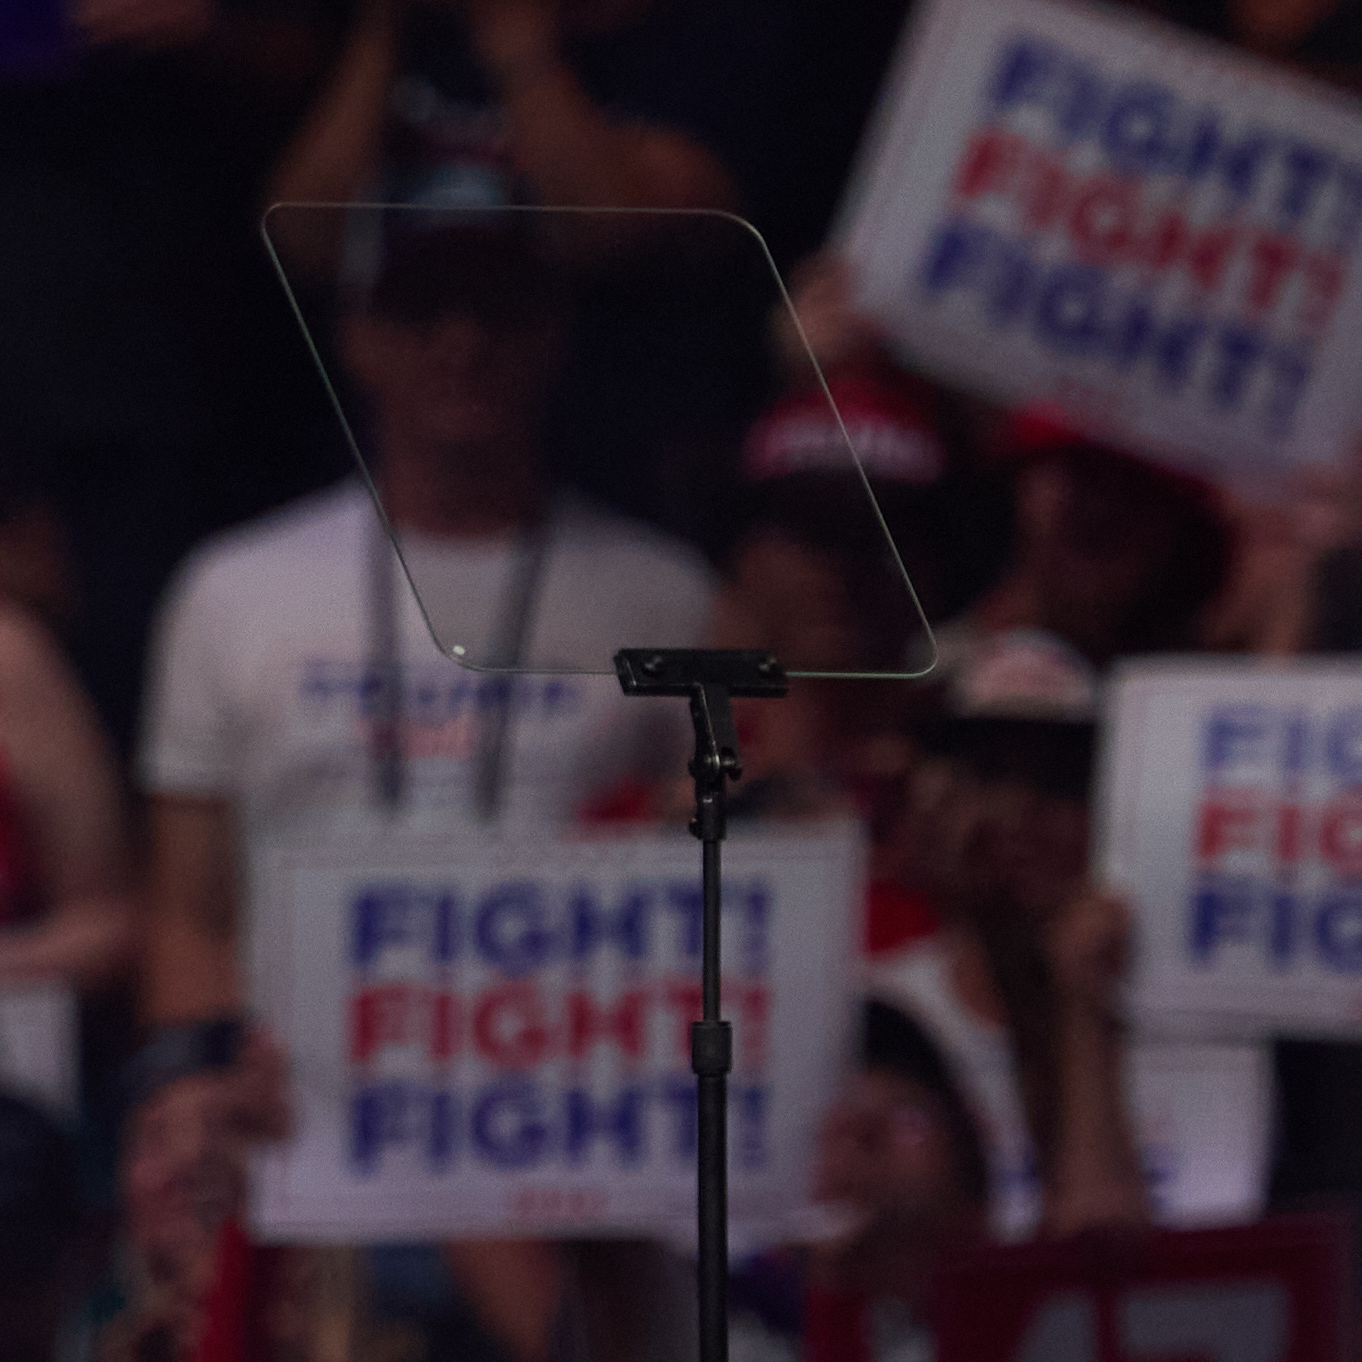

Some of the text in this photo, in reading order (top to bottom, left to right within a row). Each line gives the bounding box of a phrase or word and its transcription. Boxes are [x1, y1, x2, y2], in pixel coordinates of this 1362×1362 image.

[955, 128, 1347, 345] FIGHT!
[925, 212, 1311, 440] FIGHT!
[351, 880, 769, 974] FIGHT!
[349, 976, 771, 1072] FIGHT!
[349, 1076, 769, 1178] FIGHT!
